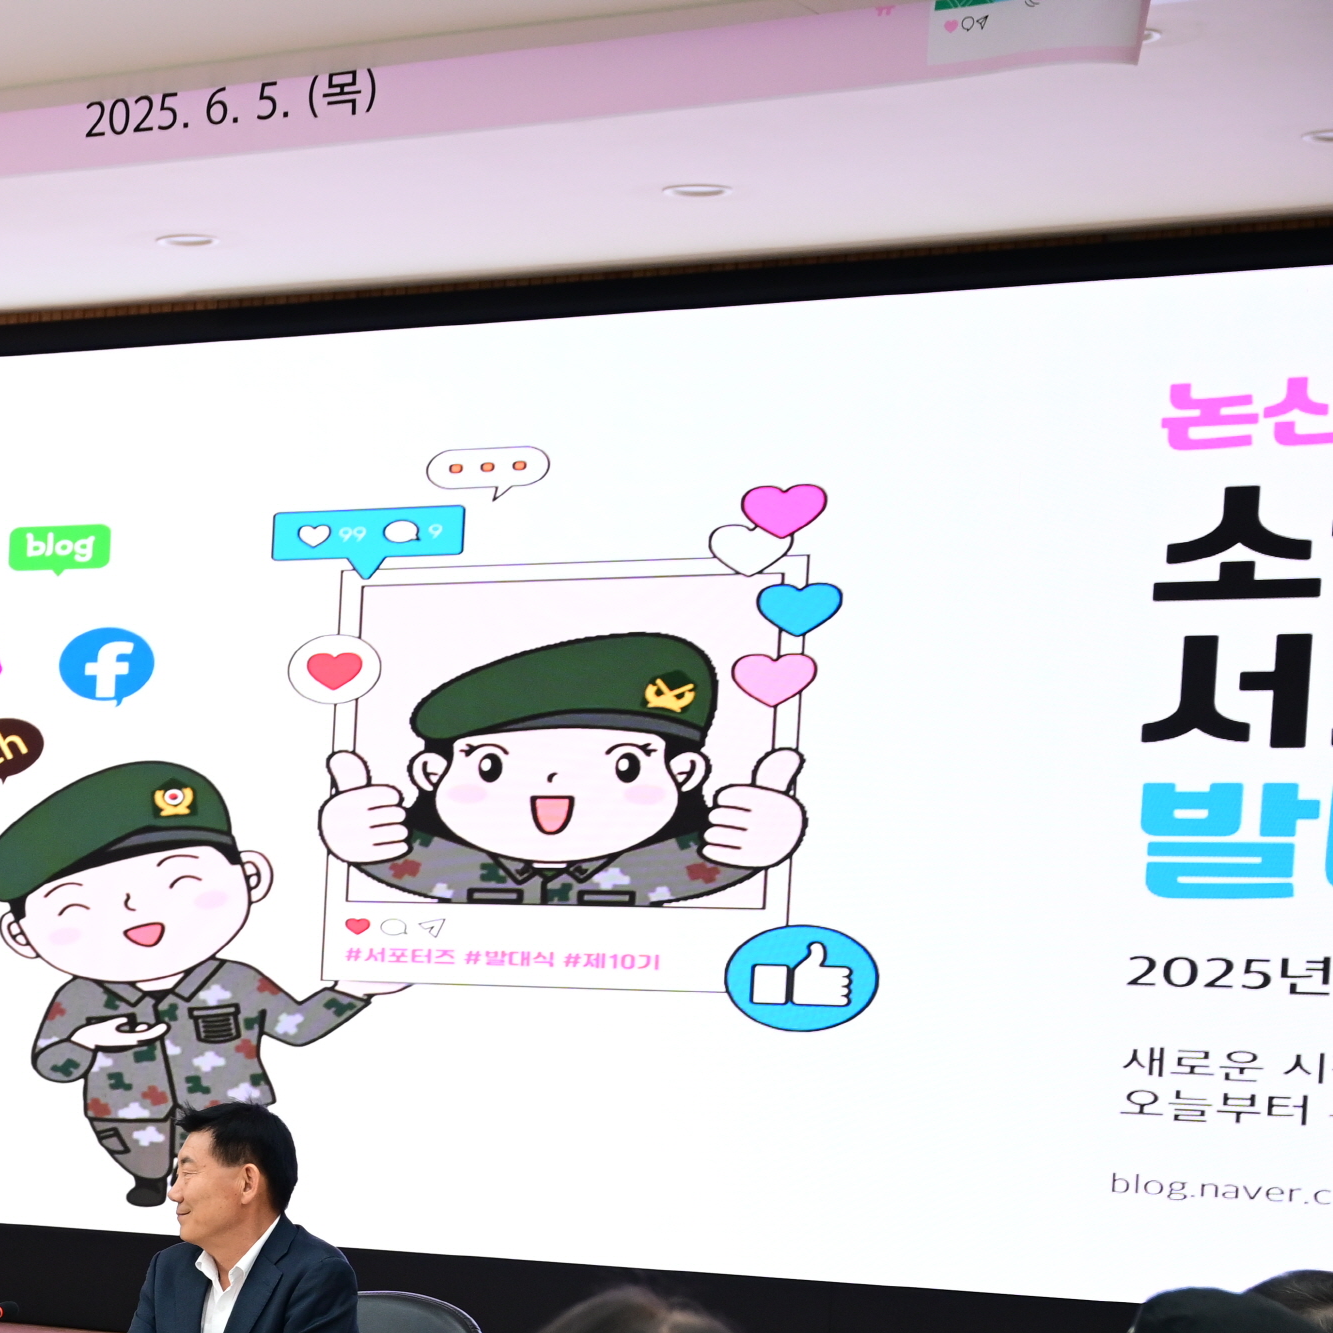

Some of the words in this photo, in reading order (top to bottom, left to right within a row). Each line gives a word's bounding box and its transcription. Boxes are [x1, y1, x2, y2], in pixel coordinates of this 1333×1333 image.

[85, 91, 189, 138] 2025.
[205, 86, 239, 125] 6.
[256, 81, 289, 121] 5.
[308, 67, 376, 118] (목)
[25, 531, 96, 562] blog
[338, 526, 367, 543] 99
[1140, 782, 1333, 899] 발
[344, 947, 457, 964] #서포터즈
[464, 950, 555, 968] #발대식
[563, 952, 661, 971] #제10기
[1126, 955, 1331, 996] 2025년
[1122, 1046, 1265, 1083] 새로운
[1120, 1089, 1309, 1127] 오늘부터
[1111, 1172, 1332, 1206] blog.naver.c
